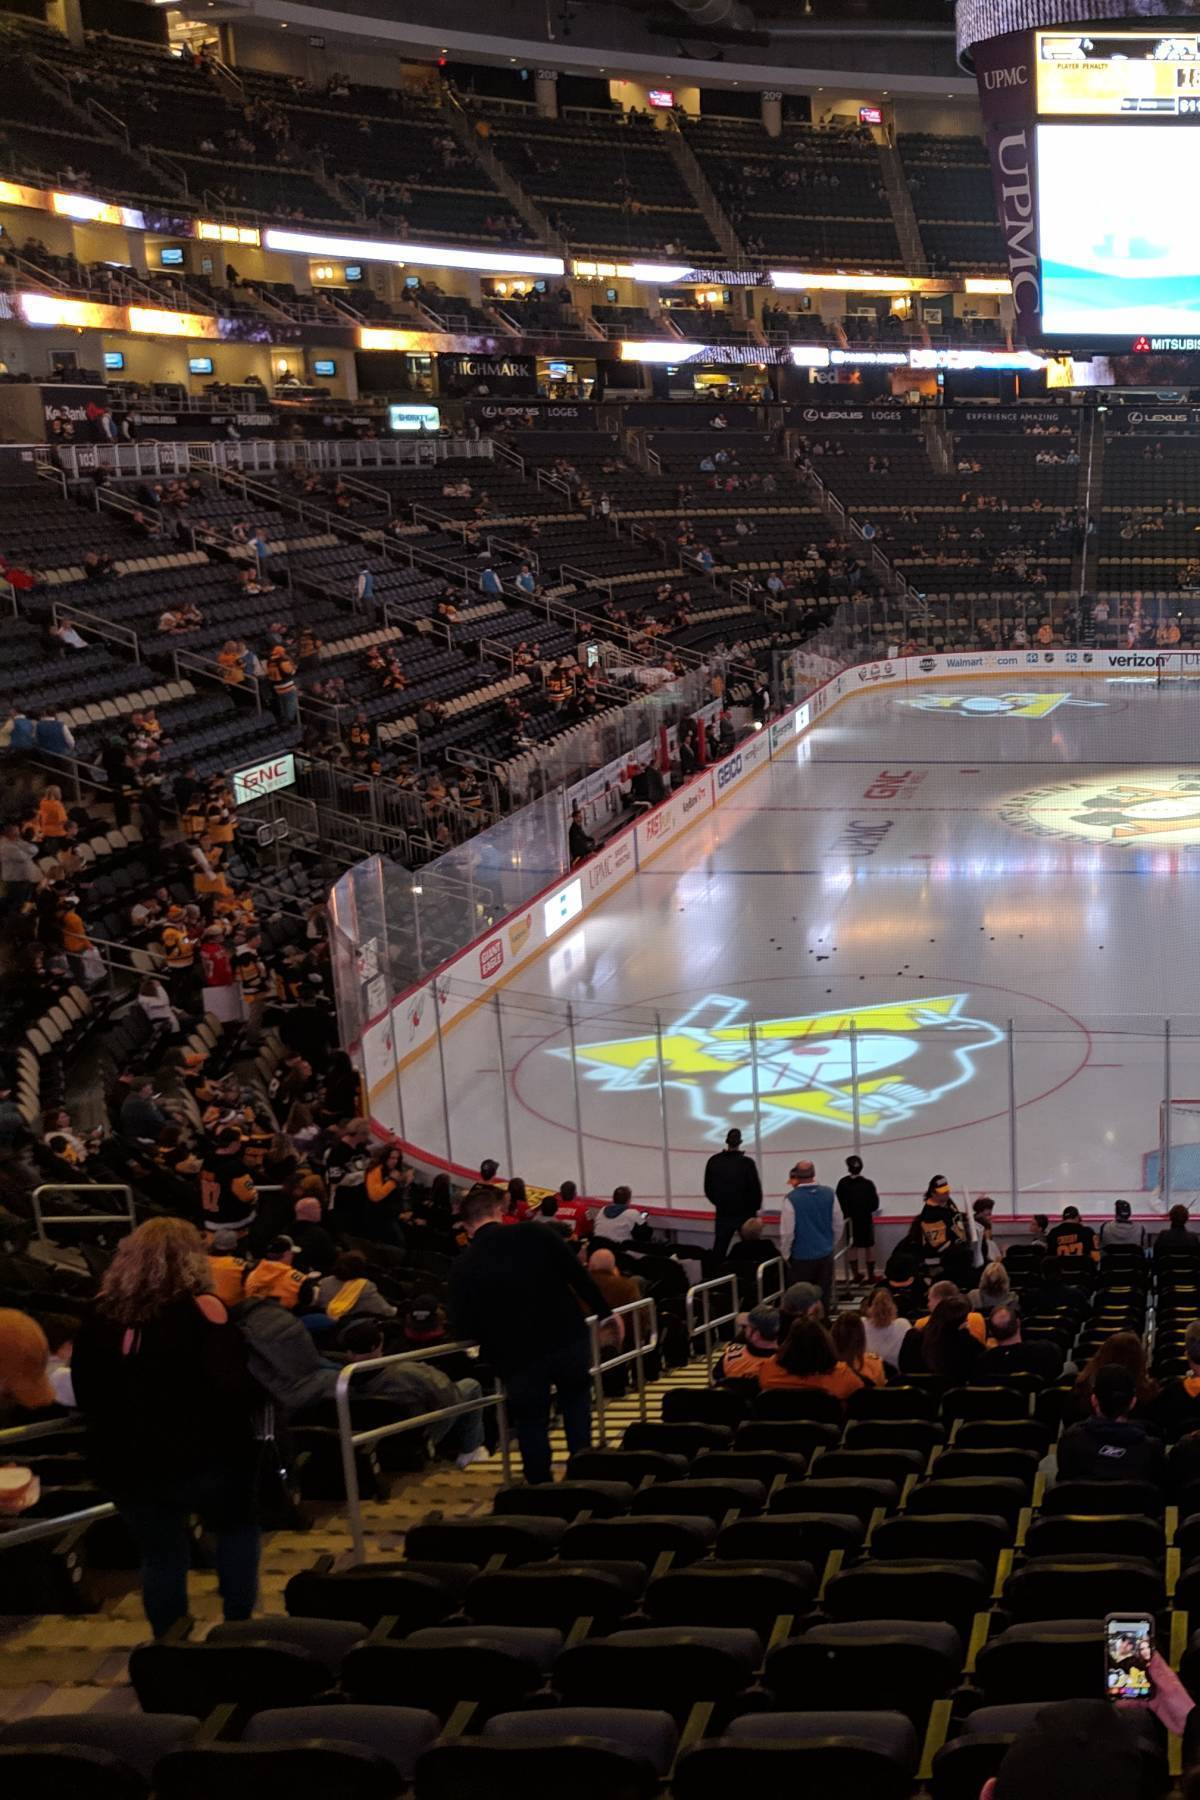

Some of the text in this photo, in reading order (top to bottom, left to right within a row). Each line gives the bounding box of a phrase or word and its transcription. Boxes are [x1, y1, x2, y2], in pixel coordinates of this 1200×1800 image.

[984, 65, 1029, 90] UPMC
[999, 129, 1040, 315] UPMC
[453, 361, 530, 376] HIGHMARK
[808, 368, 862, 385] FedEx
[548, 407, 578, 417] LOGES
[820, 411, 902, 421] LEXUS LOGES
[966, 412, 1059, 422] EXPERIENCE AMAZING
[80, 453, 95, 467] 103
[946, 657, 983, 669] Walmart
[1108, 654, 1165, 667] verizon
[243, 760, 287, 789] GNC
[864, 770, 912, 799] GNC
